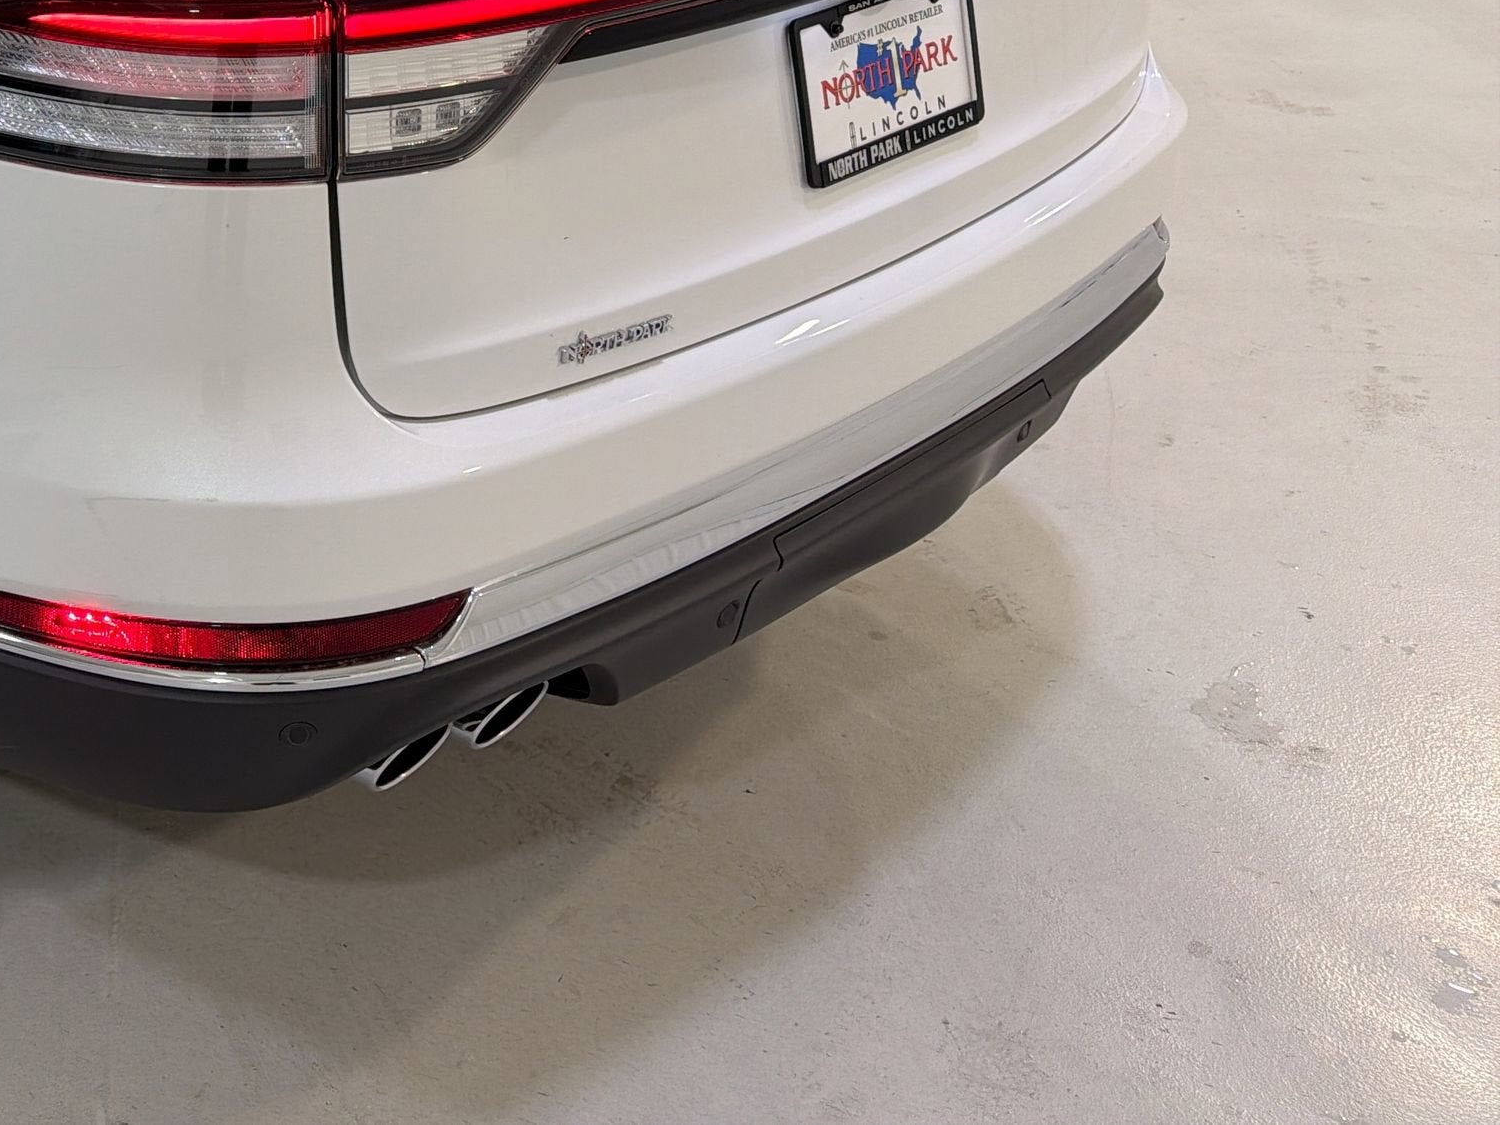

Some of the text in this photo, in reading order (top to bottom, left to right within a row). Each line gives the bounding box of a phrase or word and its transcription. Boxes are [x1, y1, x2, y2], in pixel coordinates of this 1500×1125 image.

[830, 29, 867, 52] AMERICA'S
[875, 15, 907, 36] LINCOLN
[908, 4, 944, 23] RETAILER
[821, 34, 958, 110] NORTH PARK
[828, 107, 974, 182] NORTH PARK LINCOLN
[859, 94, 947, 142] LINCOLN
